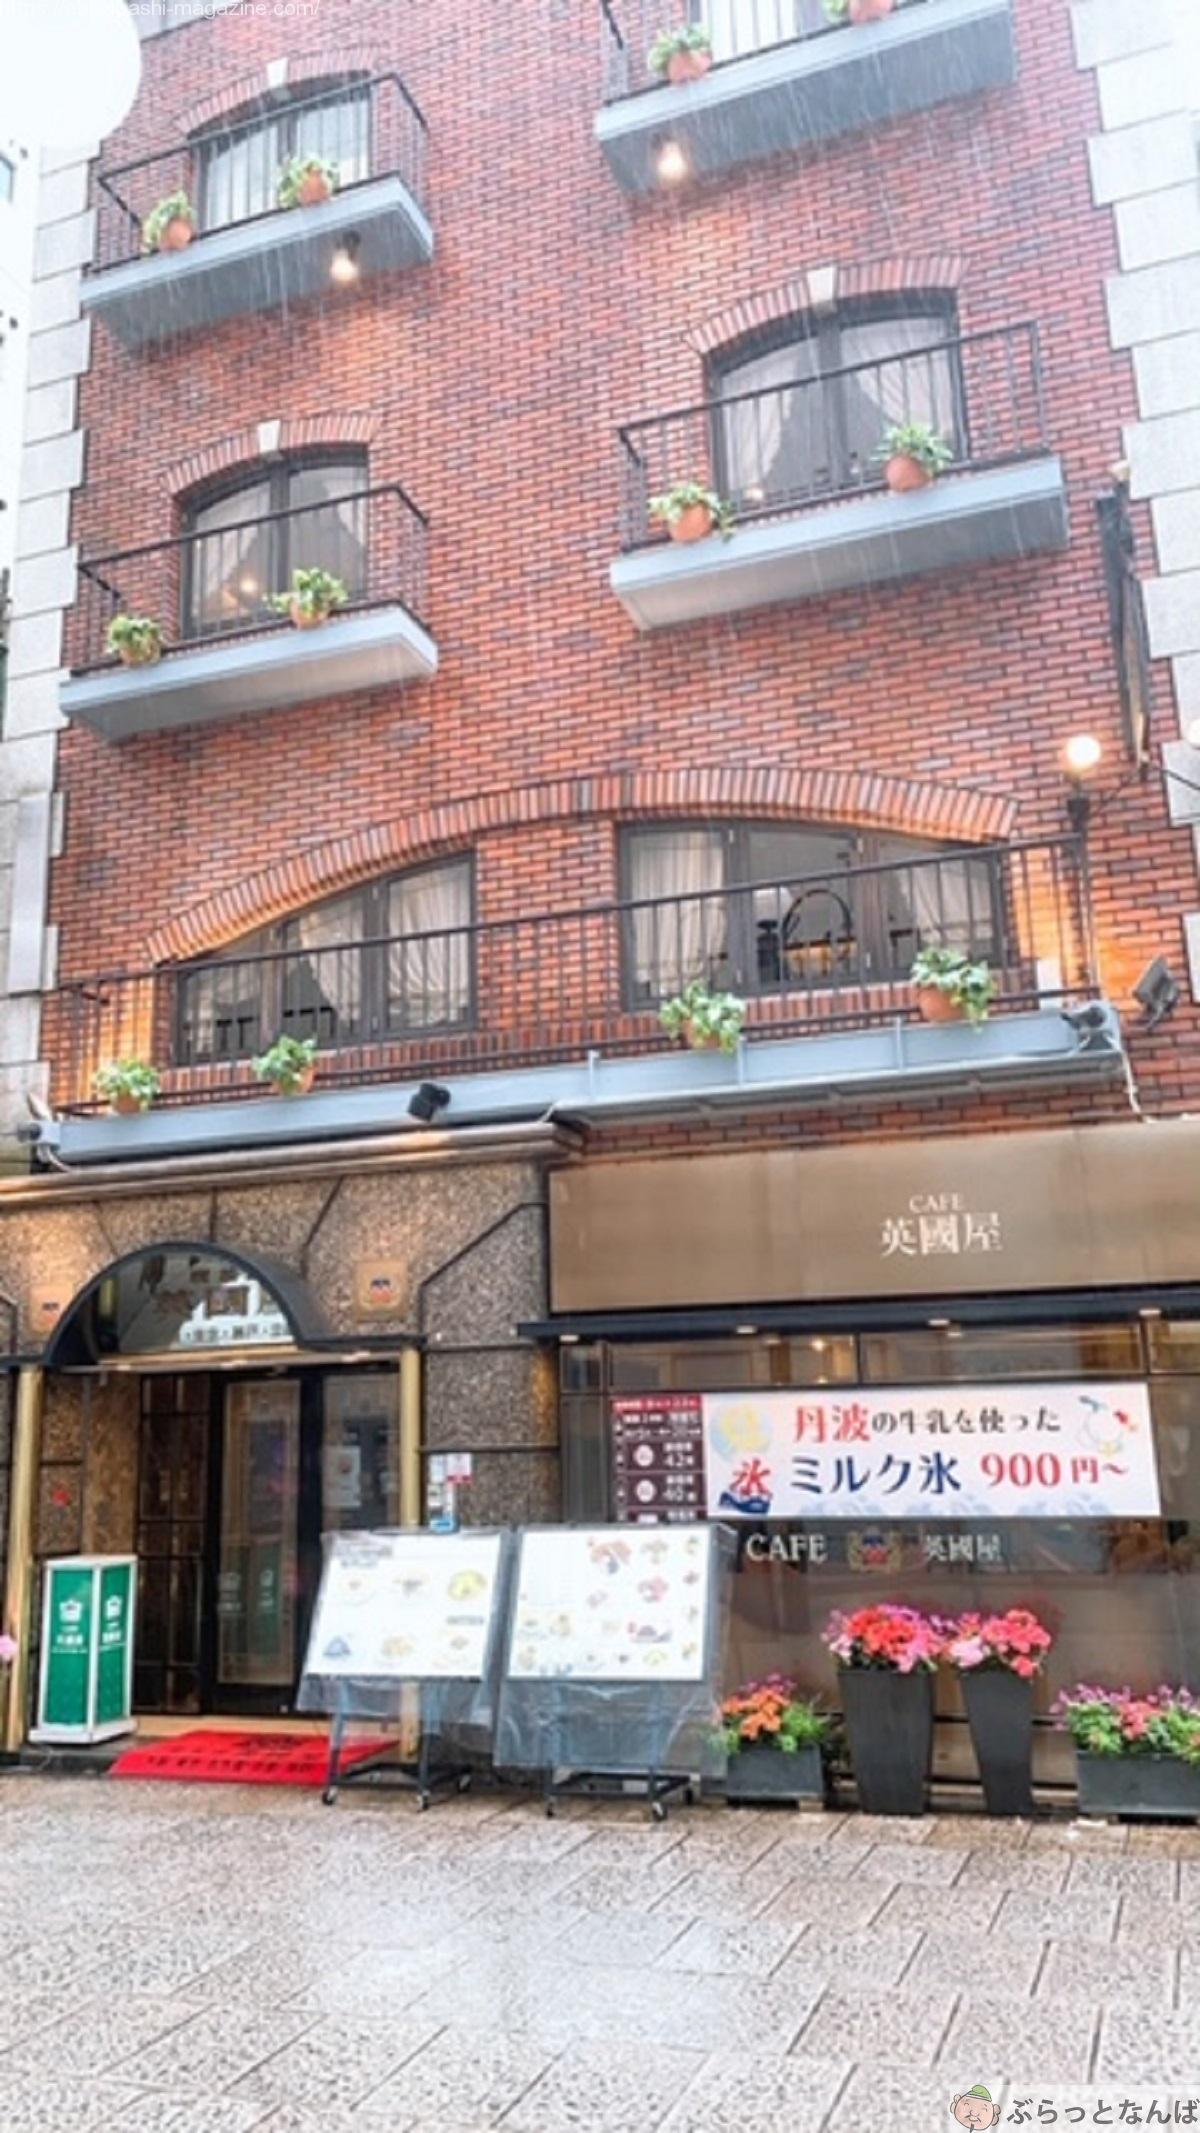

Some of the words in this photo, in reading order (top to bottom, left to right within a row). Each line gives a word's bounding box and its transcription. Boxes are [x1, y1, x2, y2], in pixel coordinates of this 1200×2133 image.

[908, 1192, 963, 1213] CAFE
[880, 1212, 1003, 1257] 英國屋
[794, 1403, 1061, 1443] 丹波の牛乳を使った
[790, 1451, 961, 1495] ミルク氷
[746, 1534, 827, 1563] CAFE
